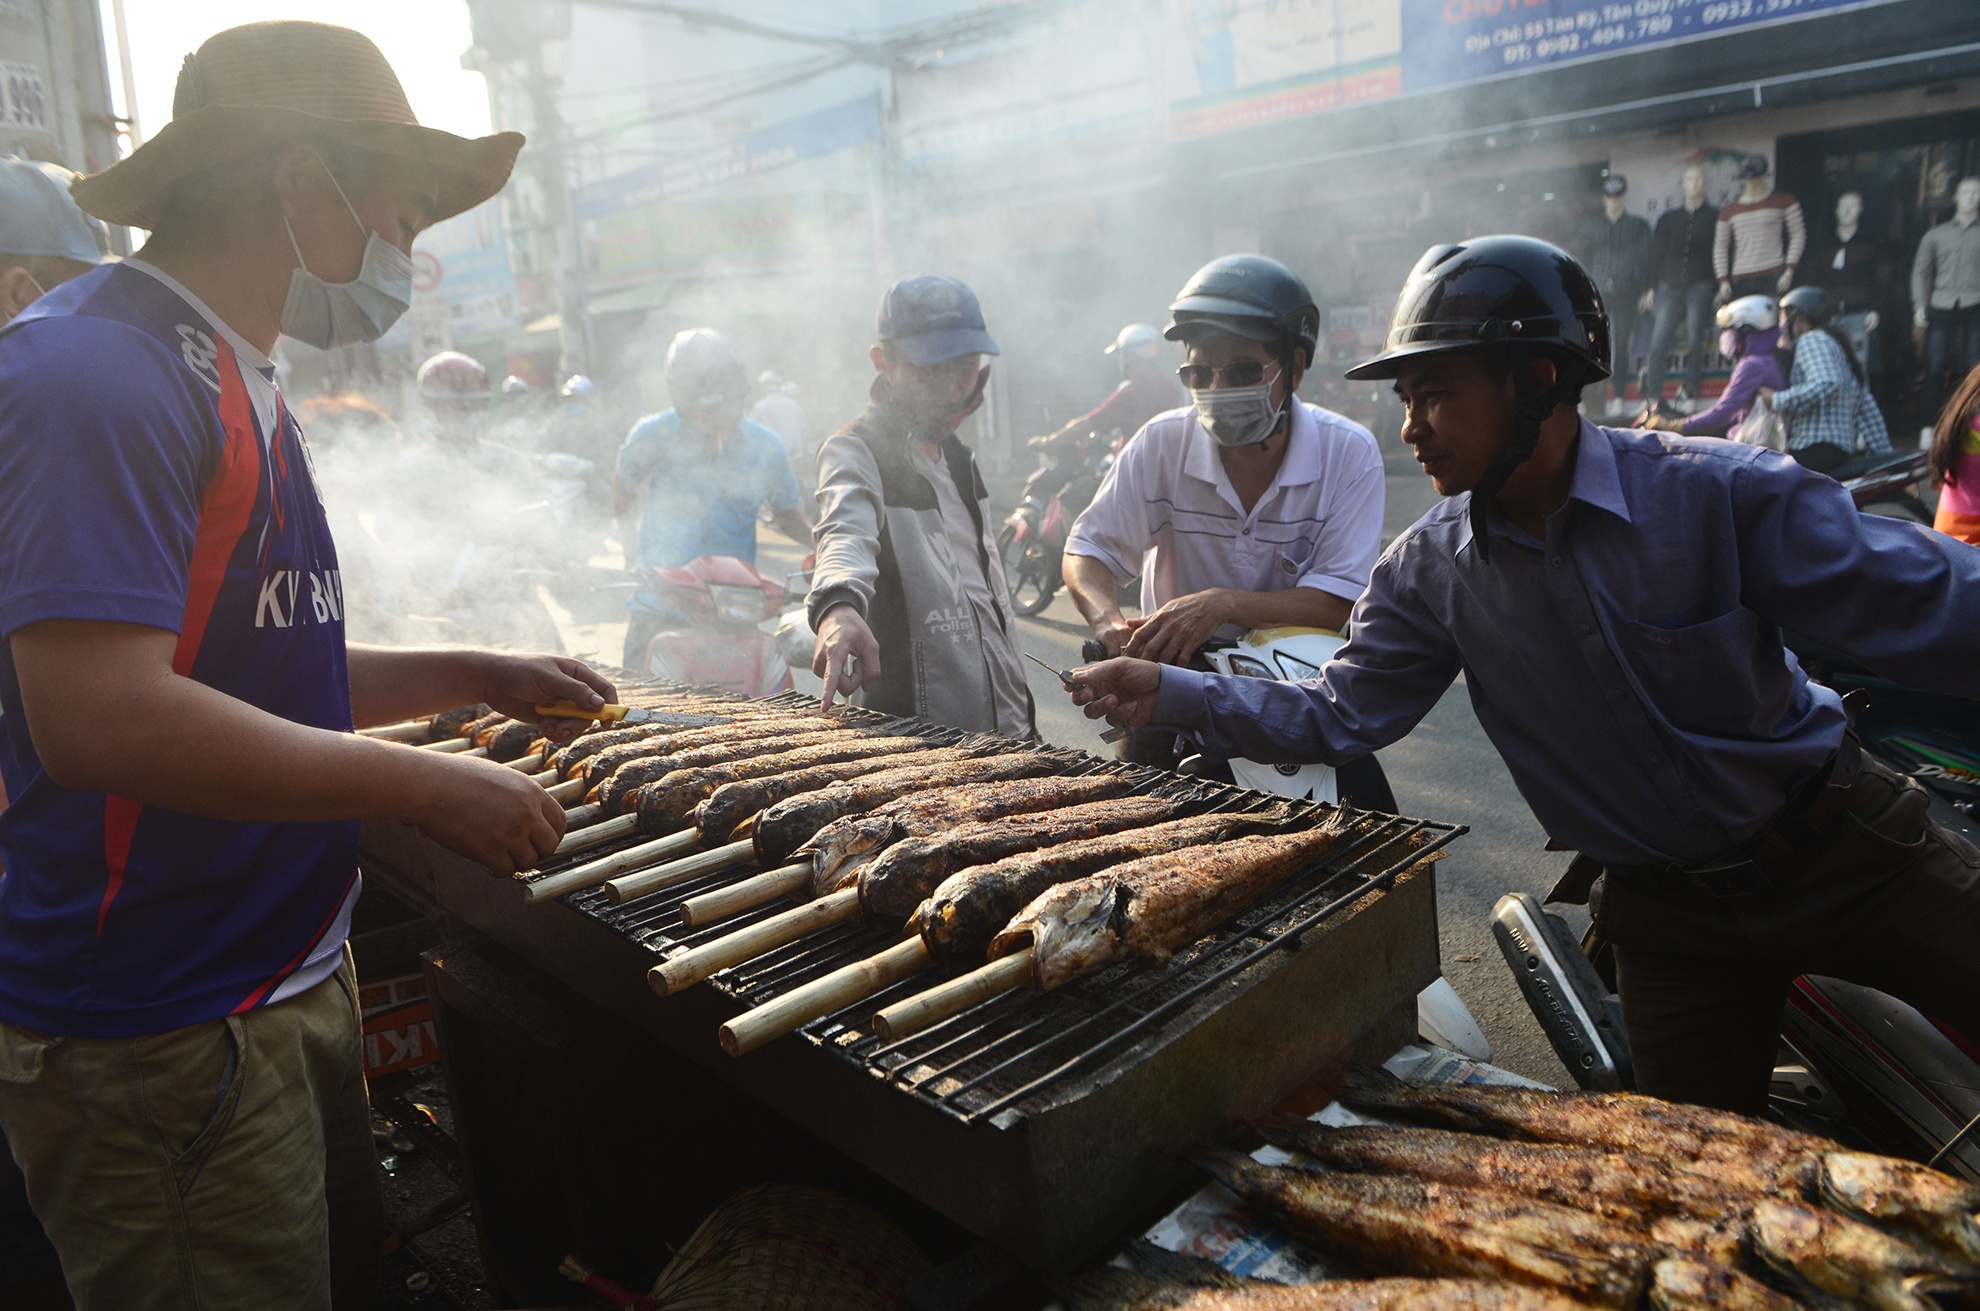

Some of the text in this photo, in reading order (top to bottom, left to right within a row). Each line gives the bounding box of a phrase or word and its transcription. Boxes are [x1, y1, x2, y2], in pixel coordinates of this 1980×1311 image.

[923, 607, 969, 625] ALL
[930, 620, 969, 634] rolls
[1509, 927, 1529, 953] NEW
